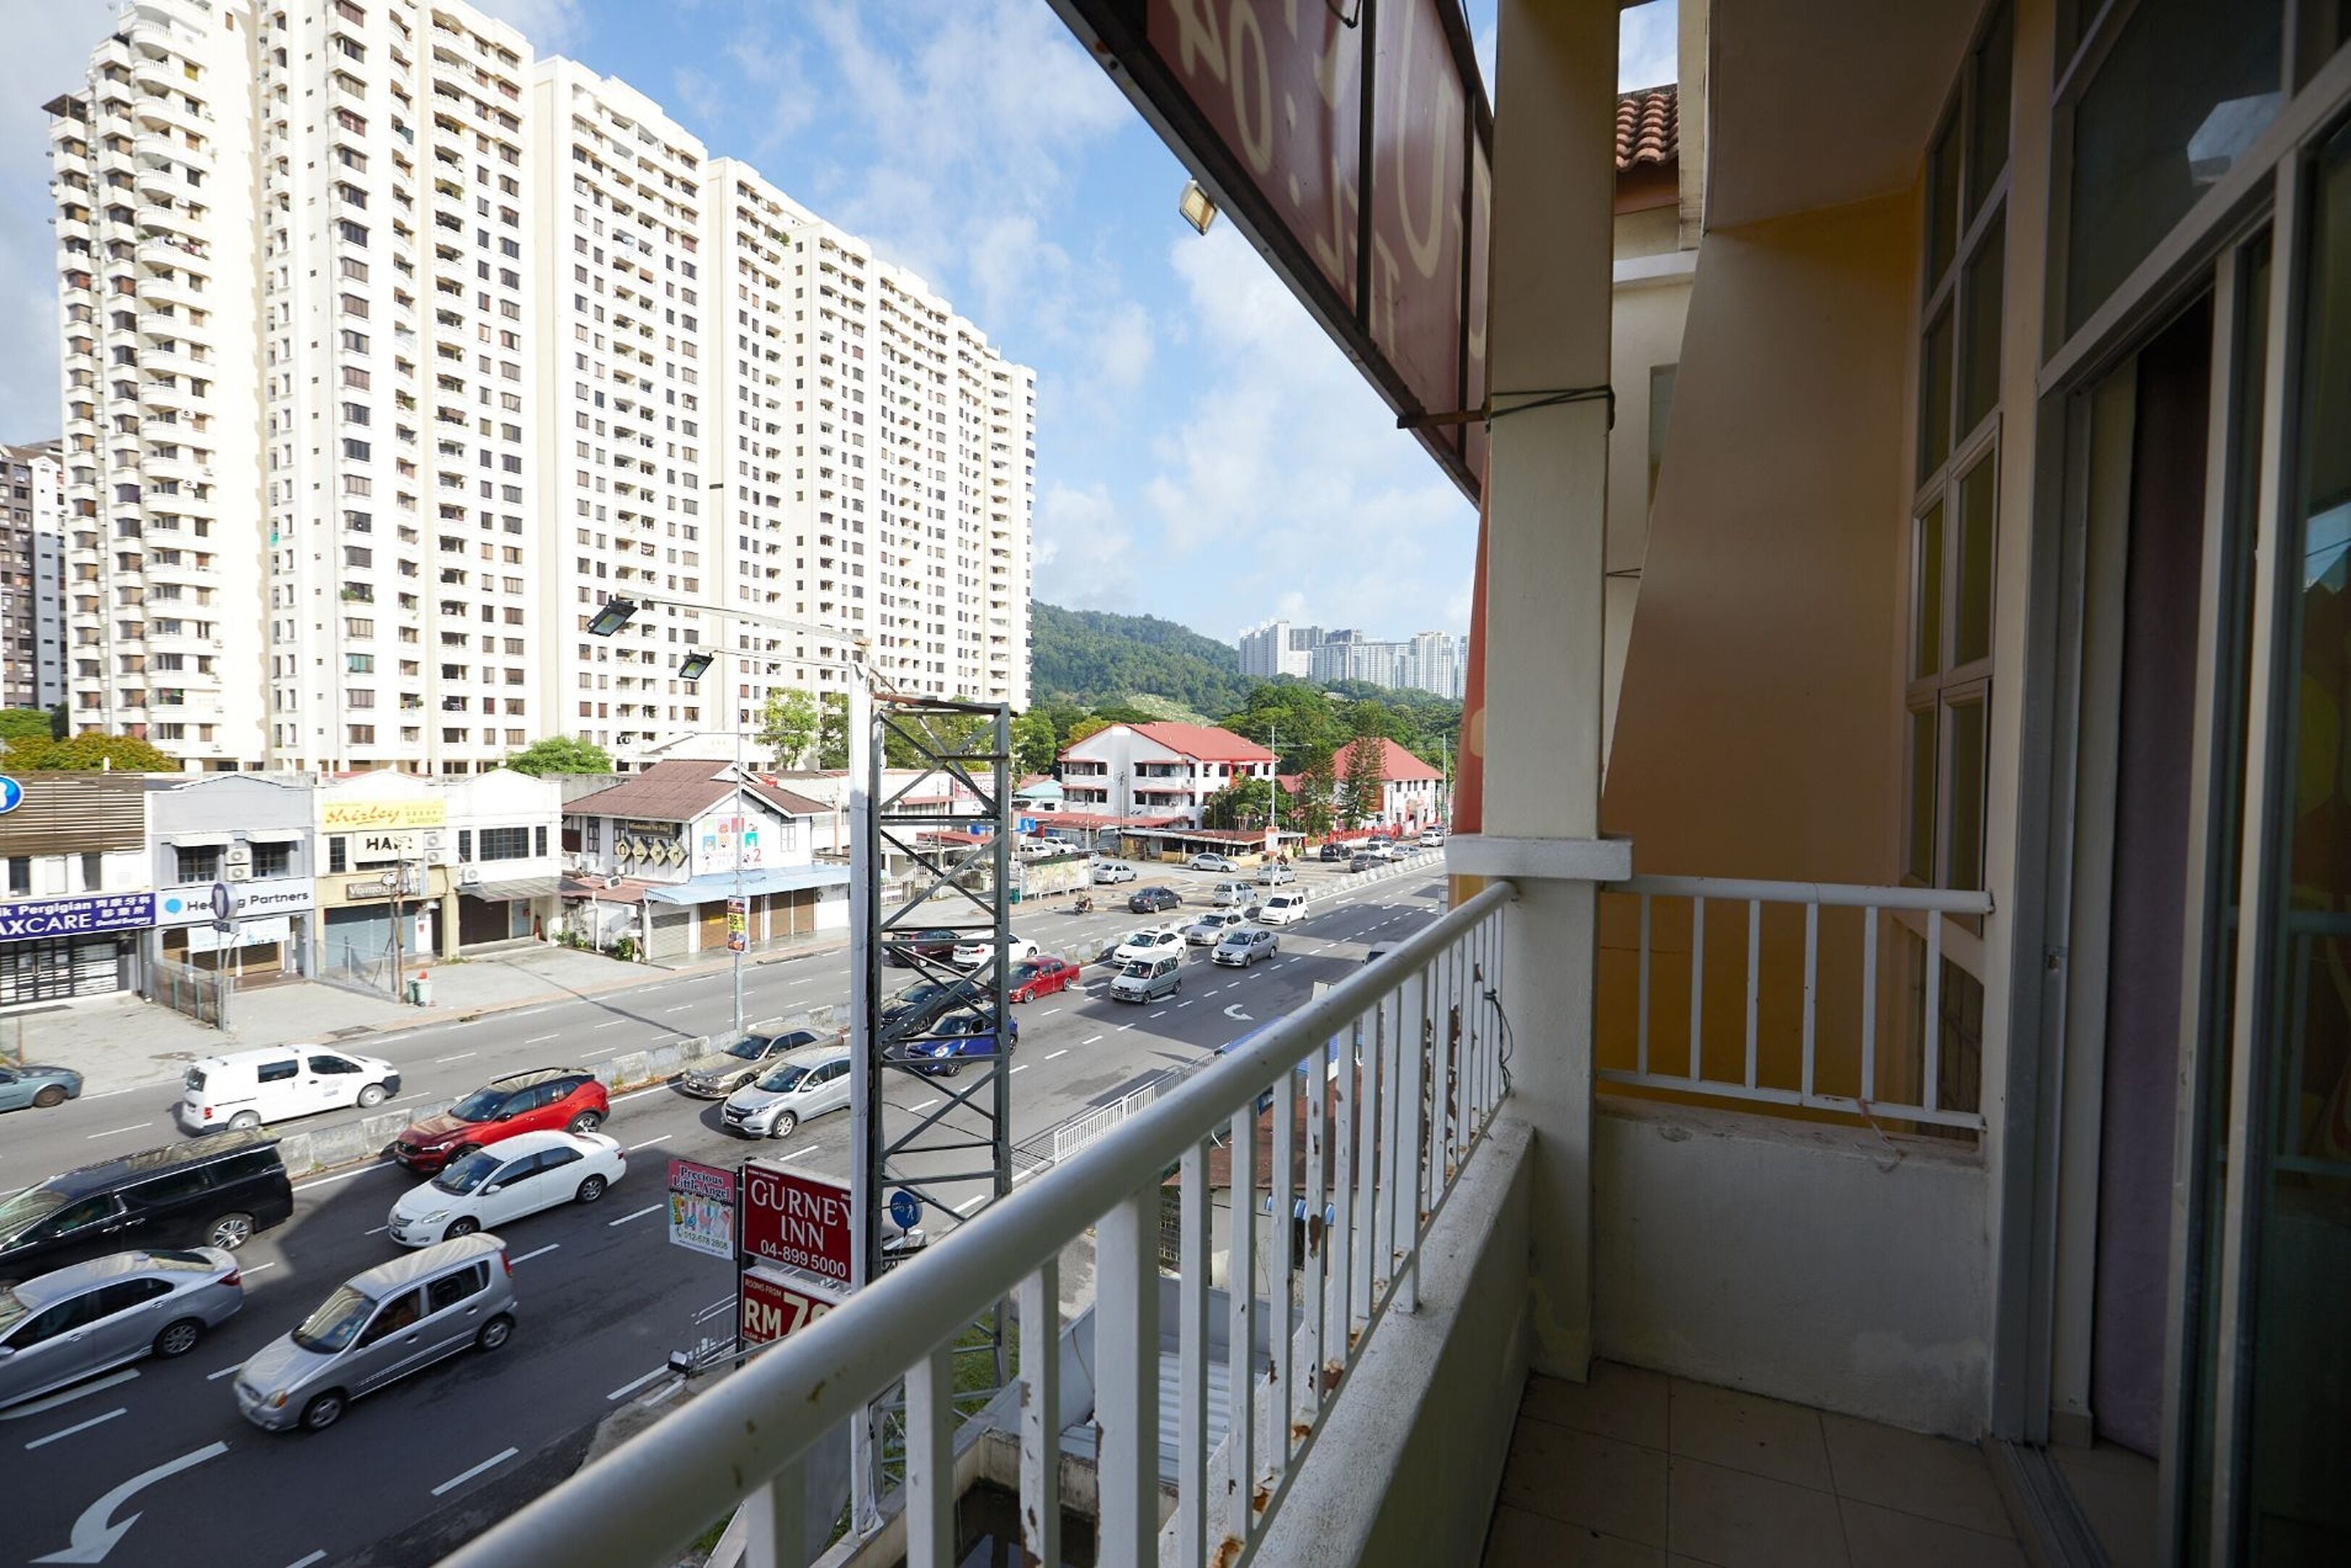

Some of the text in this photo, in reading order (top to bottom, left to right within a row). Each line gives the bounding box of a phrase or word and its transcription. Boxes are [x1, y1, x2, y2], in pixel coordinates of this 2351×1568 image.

[17, 901, 92, 916] Pergigian
[251, 892, 309, 905] Partners
[672, 1175, 730, 1200] Little Angel
[679, 1165, 724, 1186] Precious
[751, 1179, 851, 1230] GURNEY
[781, 1215, 824, 1252] INN
[760, 1239, 846, 1278] 04-899 5000
[745, 1297, 781, 1338] RM
